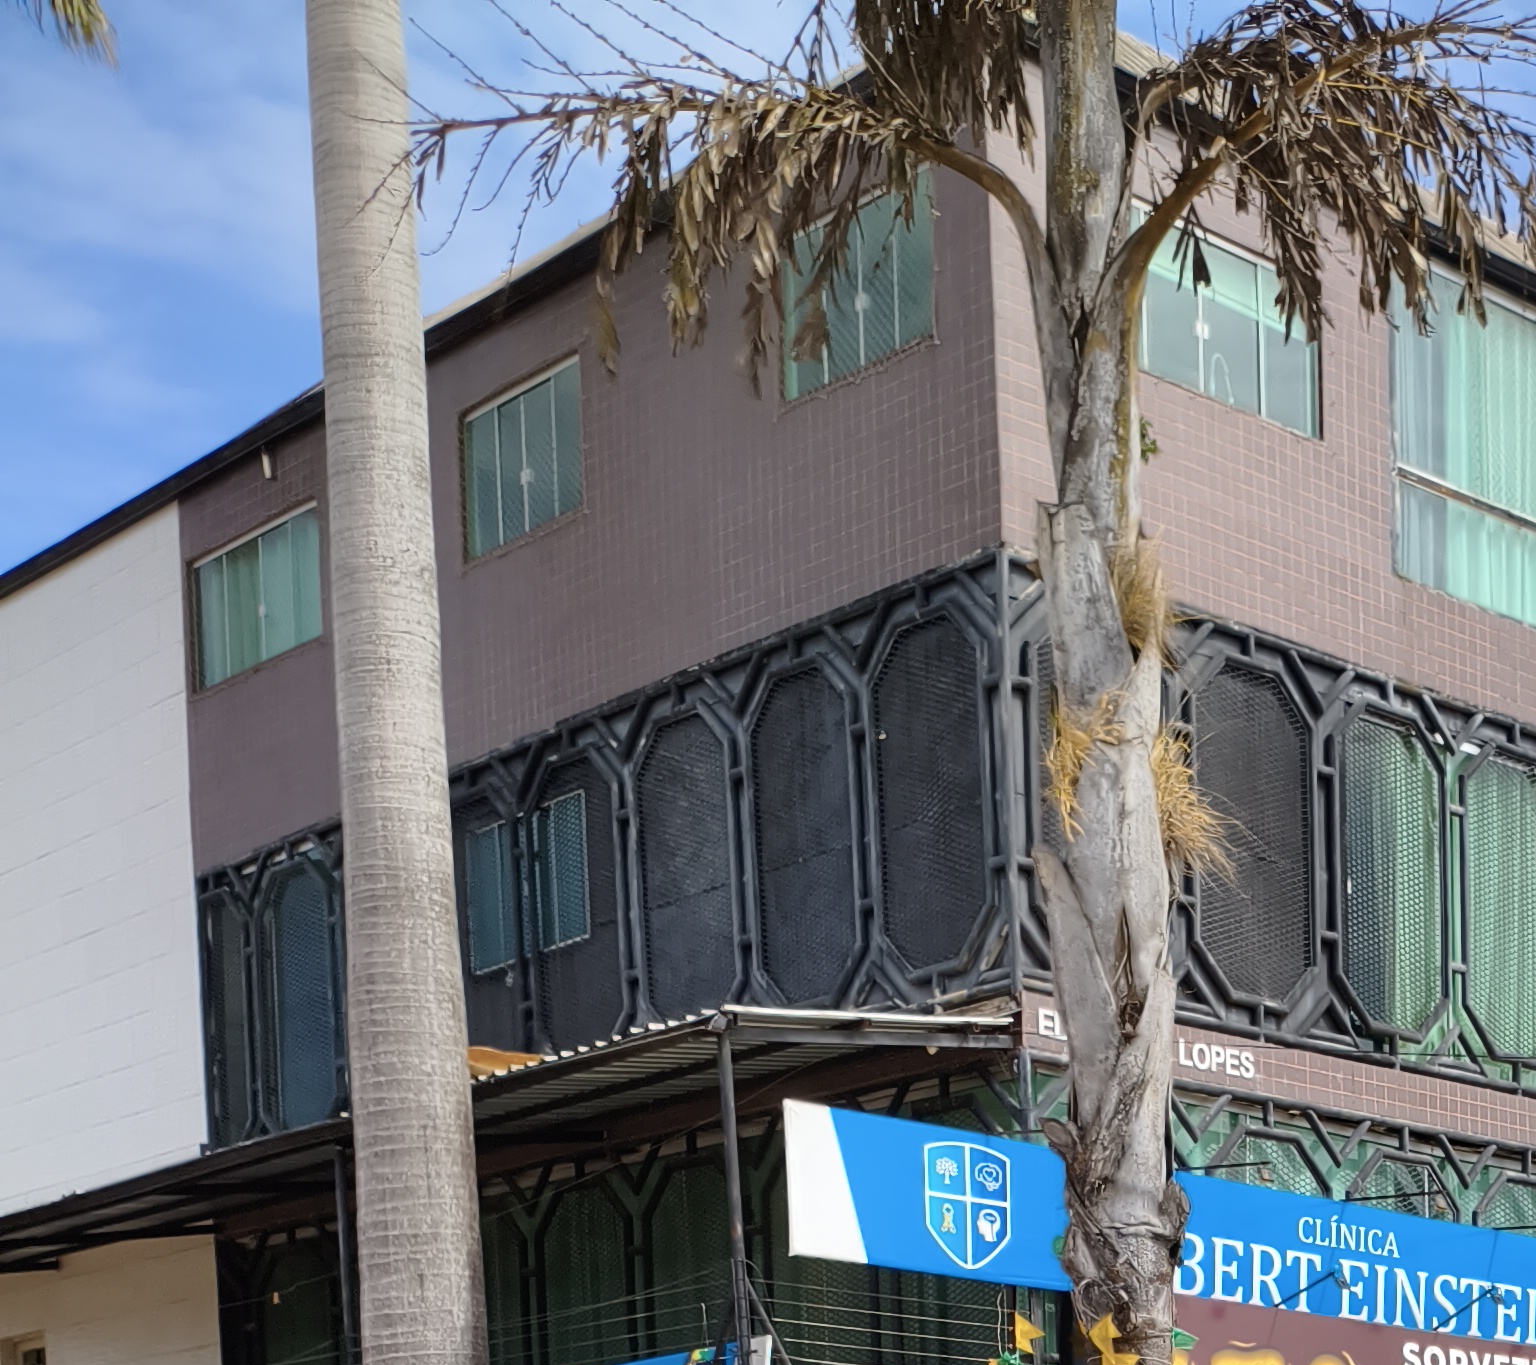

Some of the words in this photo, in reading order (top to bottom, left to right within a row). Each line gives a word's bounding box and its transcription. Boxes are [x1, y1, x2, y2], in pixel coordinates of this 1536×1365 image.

[1178, 1038, 1256, 1079] LOPES
[1299, 1214, 1401, 1259] CLÍNICA
[1172, 1231, 1322, 1314] BERT
